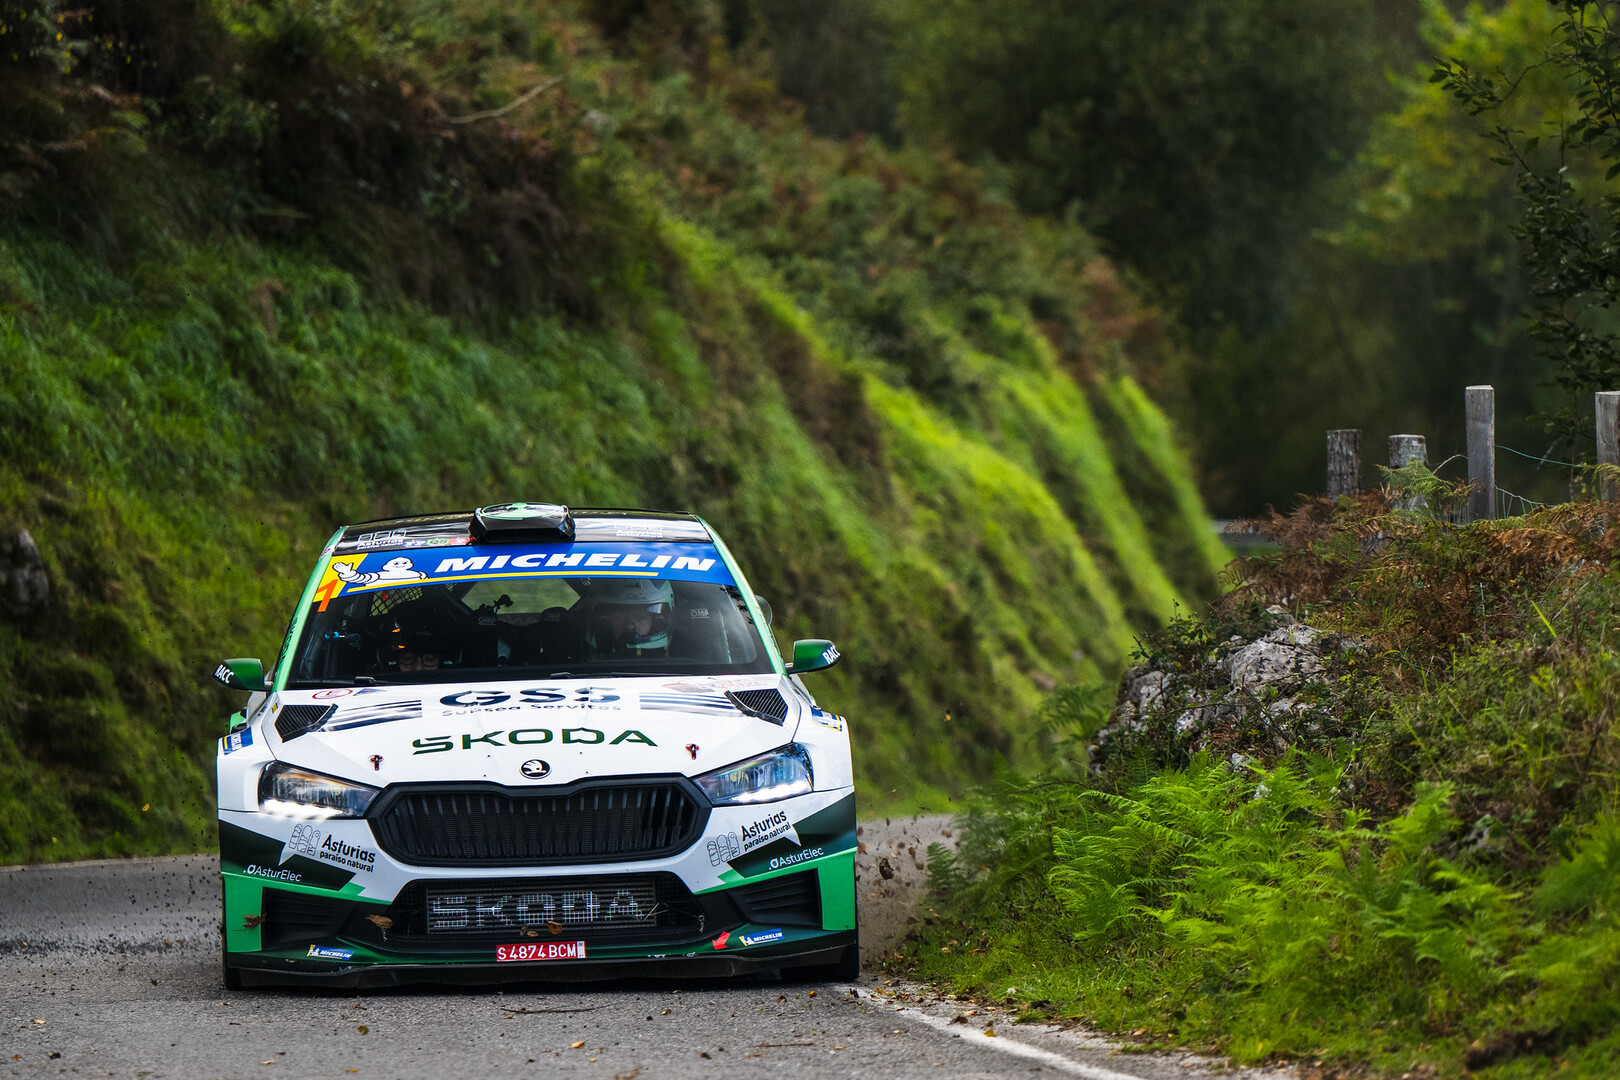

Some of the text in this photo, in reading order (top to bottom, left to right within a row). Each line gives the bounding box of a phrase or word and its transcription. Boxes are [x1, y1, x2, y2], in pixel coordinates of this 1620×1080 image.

[434, 552, 717, 573] MICHELIN
[316, 579, 339, 613] 1
[478, 617, 496, 625] OMP
[214, 664, 235, 684] RACC
[740, 811, 787, 841] Asturias
[769, 821, 792, 839] natural
[322, 834, 376, 863] Asturias
[346, 859, 374, 873] natural
[753, 932, 783, 942] MICHELIN
[319, 950, 353, 958] MICHELIN
[497, 946, 507, 961] S
[509, 944, 547, 960] 4874
[548, 942, 577, 959] BCM
